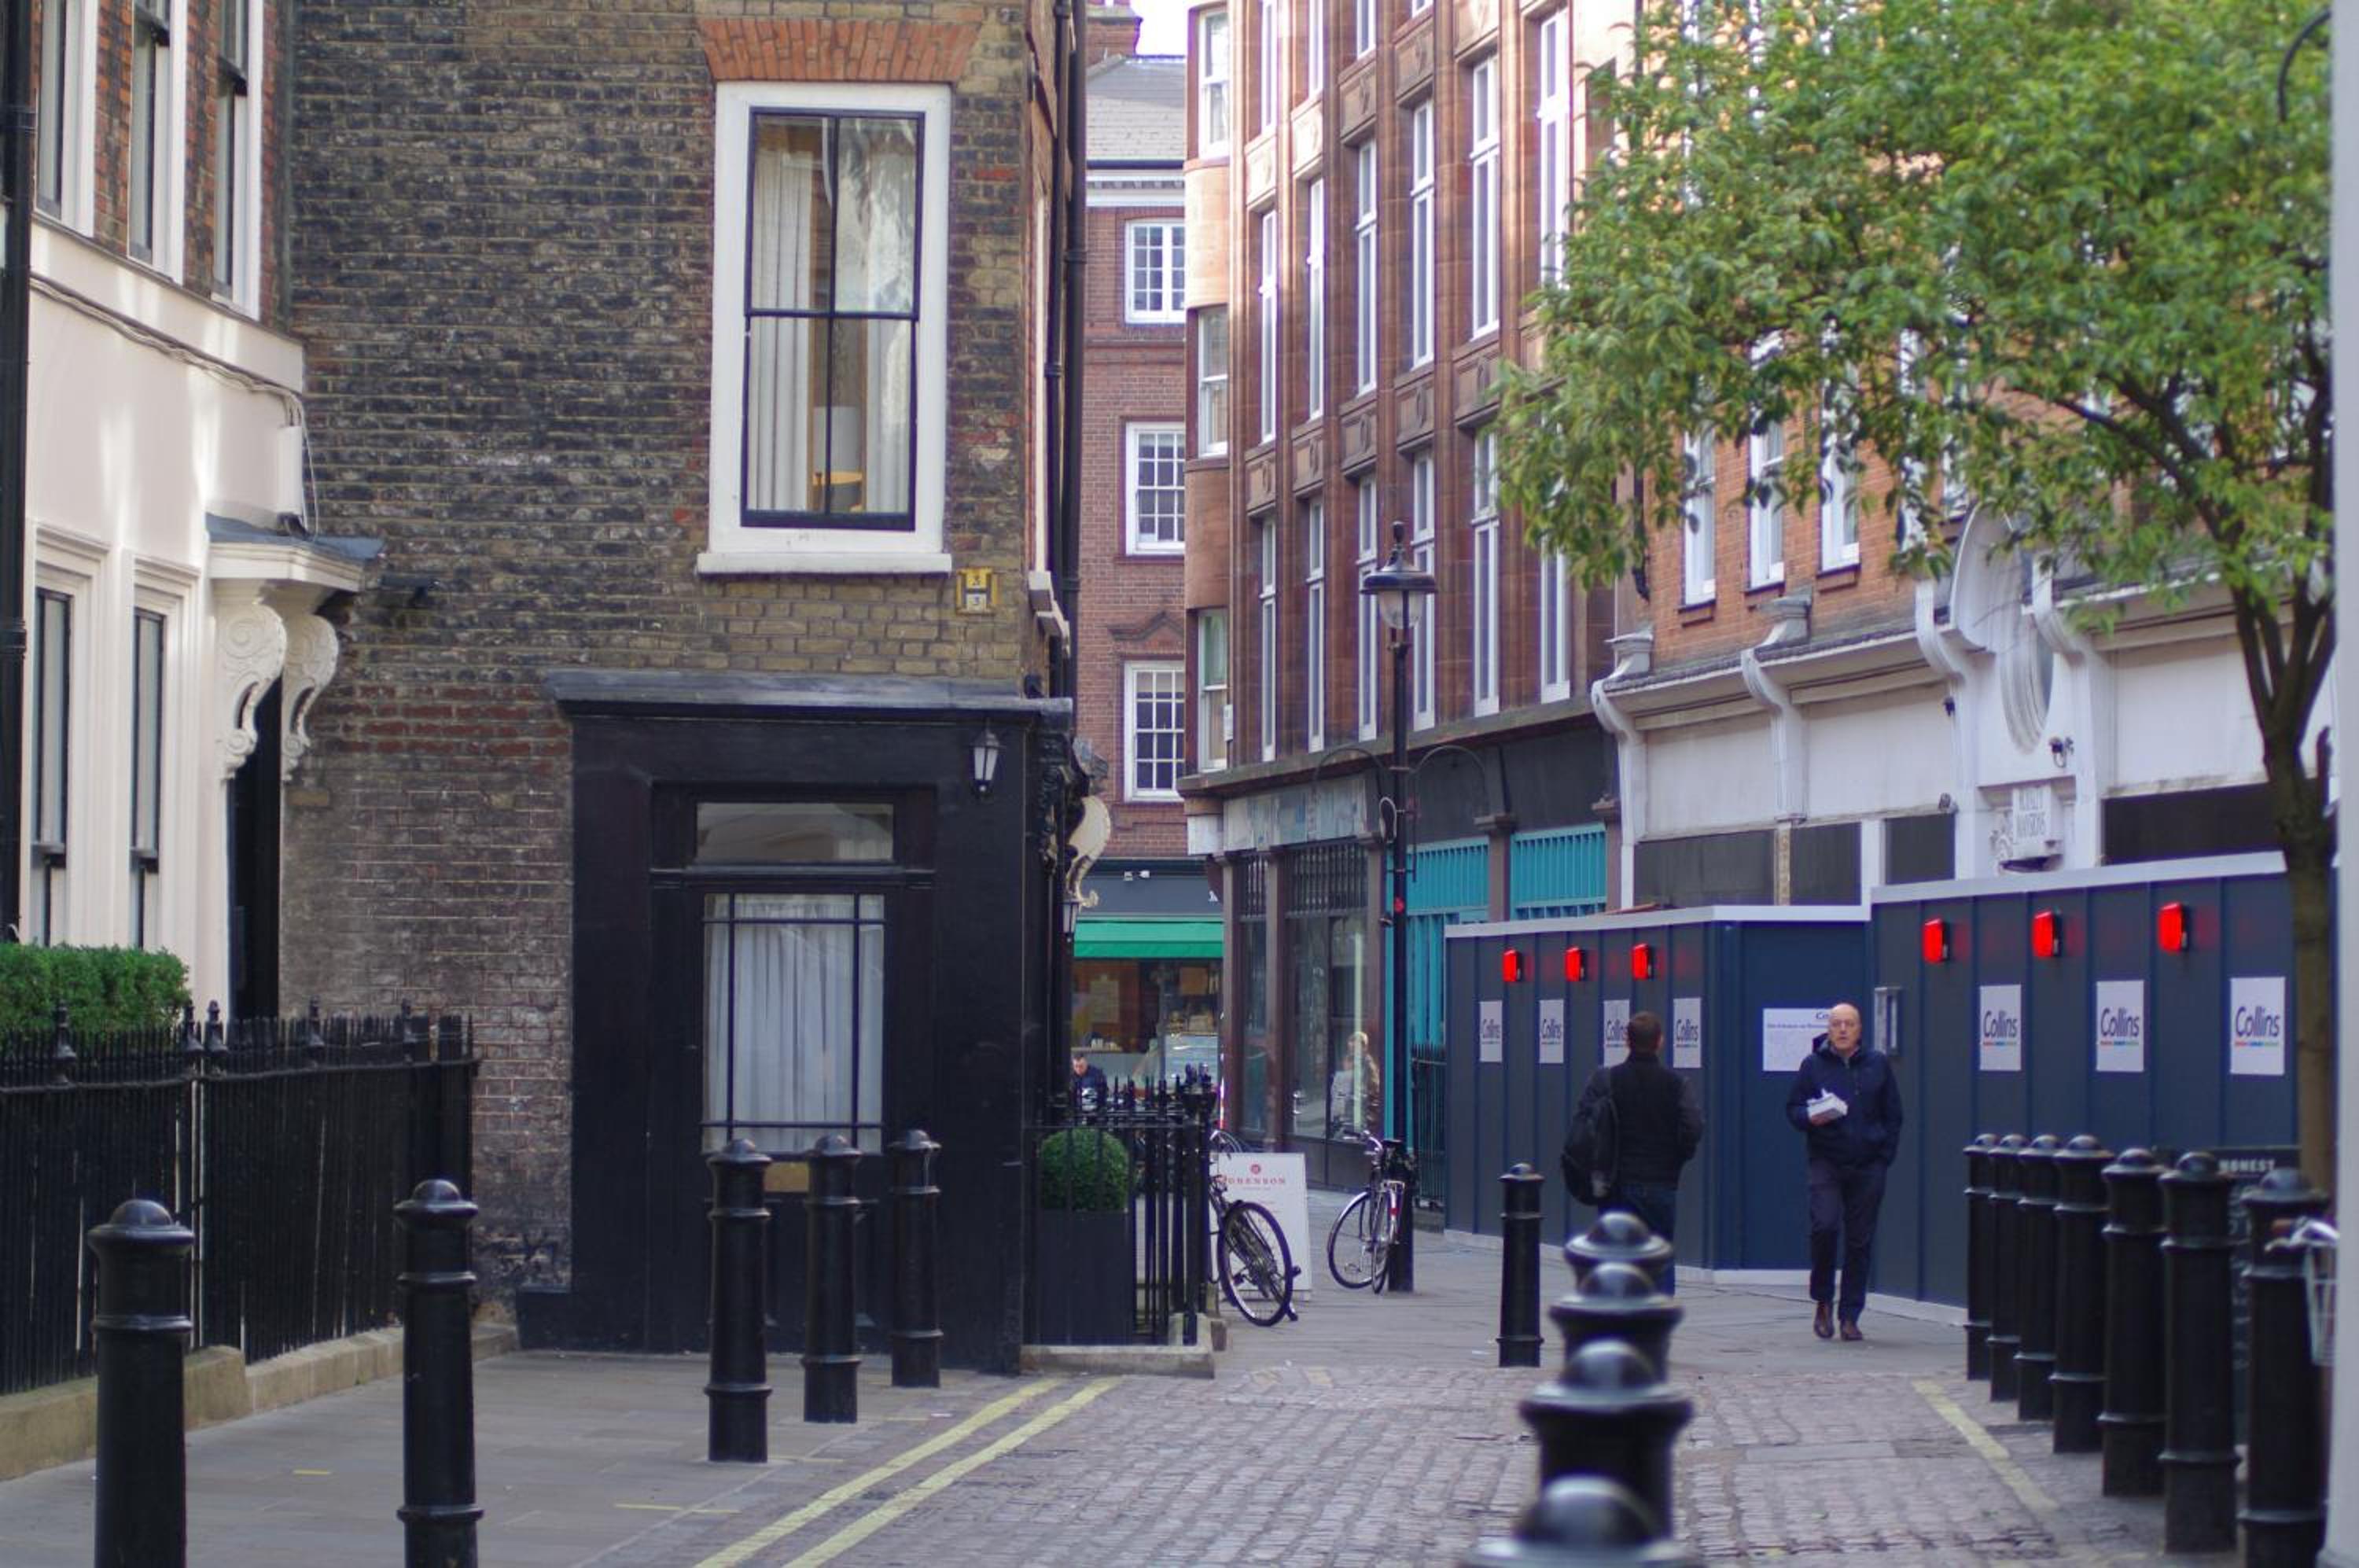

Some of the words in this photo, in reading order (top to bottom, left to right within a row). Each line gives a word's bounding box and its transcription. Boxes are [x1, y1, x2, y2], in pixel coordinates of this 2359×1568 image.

[1676, 1019, 1698, 1043] Collins
[1983, 1010, 2018, 1037] Collins
[2100, 1007, 2140, 1036] Collins
[2236, 1006, 2280, 1037] Collins
